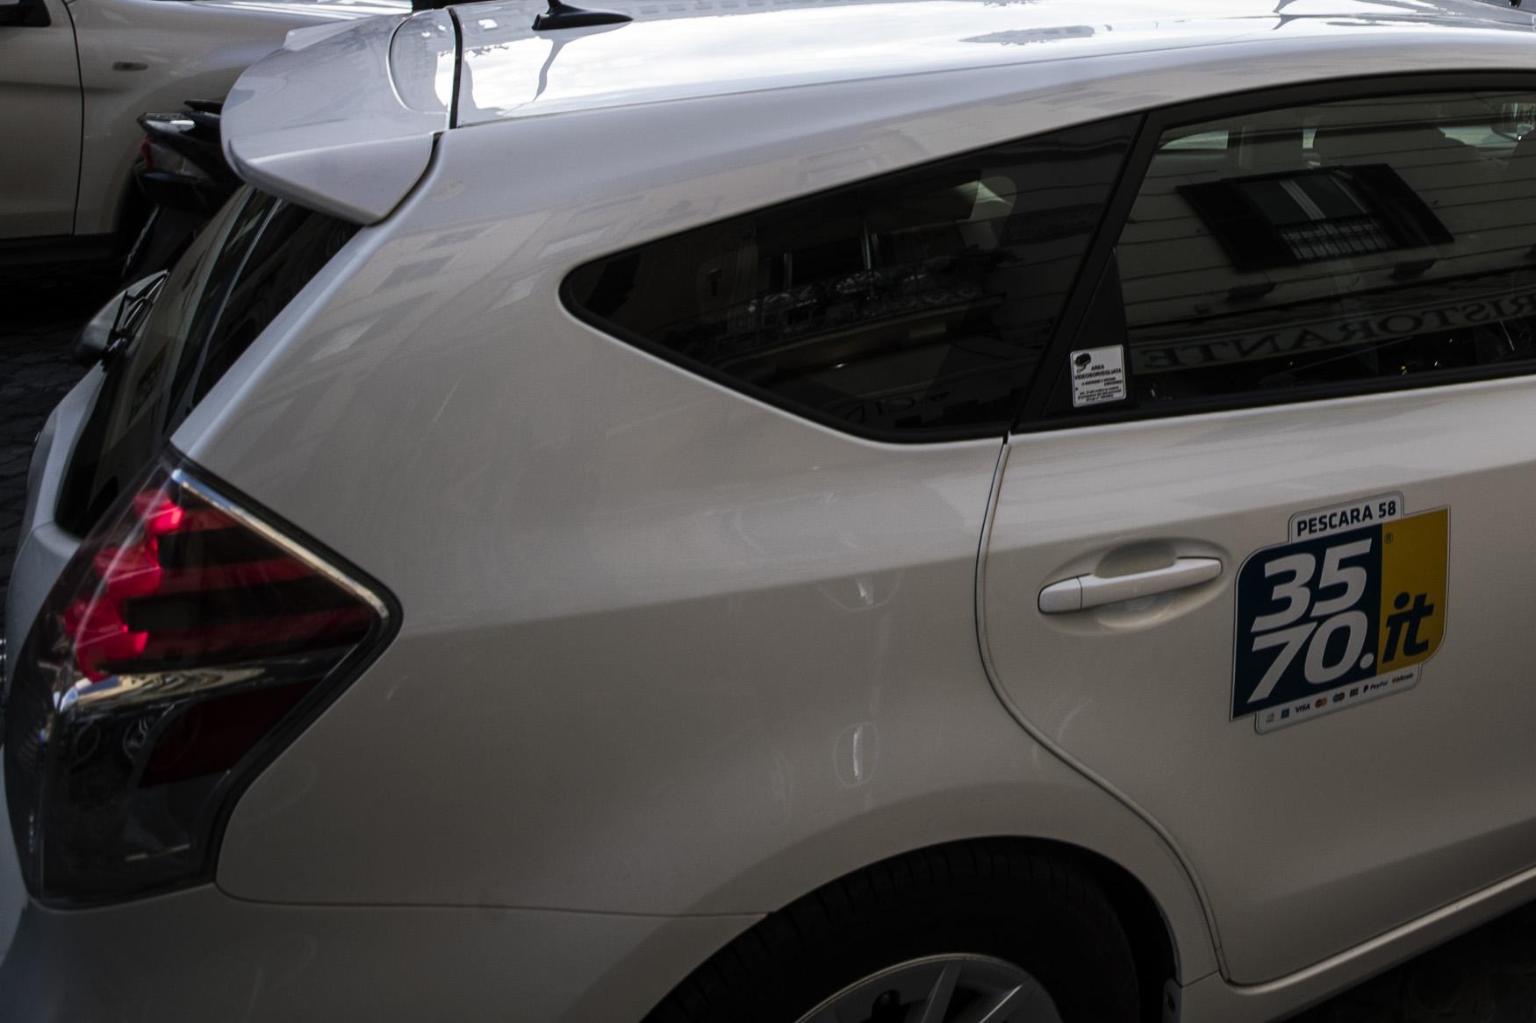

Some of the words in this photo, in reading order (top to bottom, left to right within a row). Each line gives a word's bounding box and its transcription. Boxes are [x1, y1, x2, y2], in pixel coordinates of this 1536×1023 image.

[1296, 508, 1373, 537] PESCARA
[1378, 500, 1396, 519] 58
[1250, 538, 1372, 633] 35
